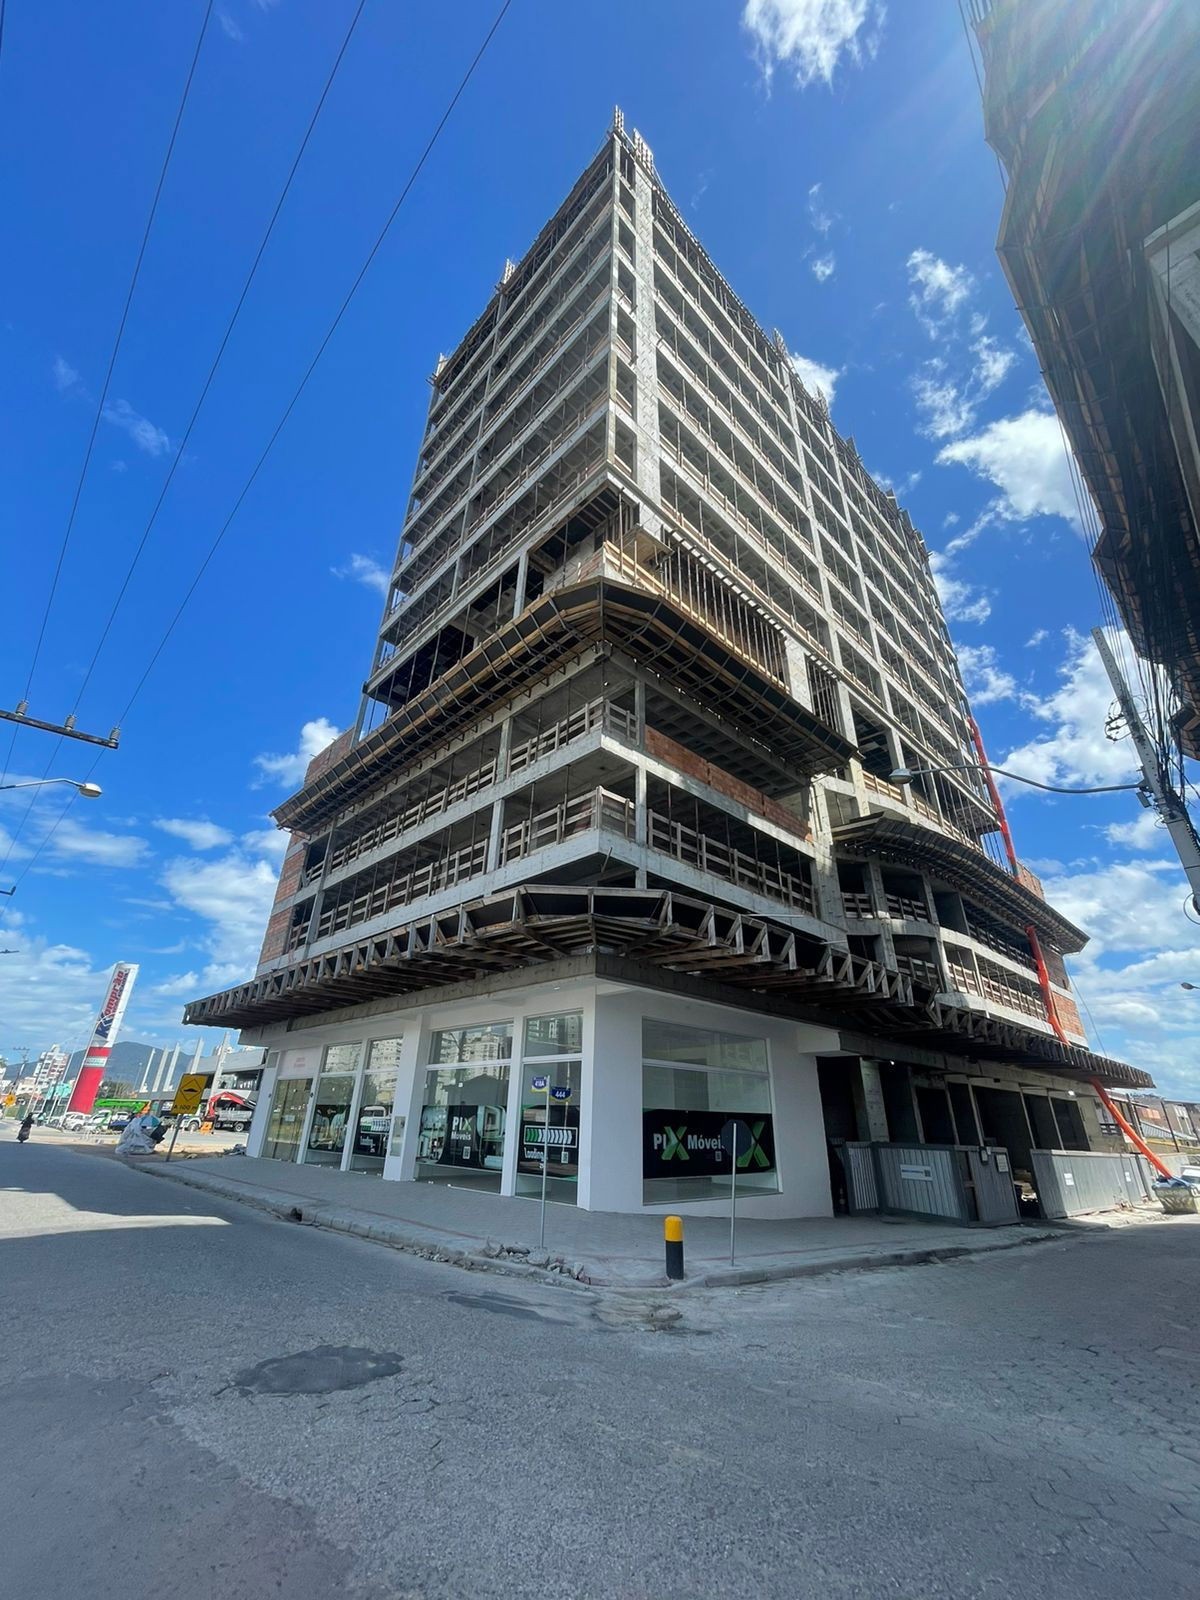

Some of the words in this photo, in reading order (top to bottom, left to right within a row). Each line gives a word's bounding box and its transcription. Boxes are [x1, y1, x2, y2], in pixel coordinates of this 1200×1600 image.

[555, 1090, 566, 1098] 444
[452, 1115, 475, 1131] PIX
[653, 1126, 690, 1160] PIX
[687, 1134, 726, 1150] Móvei
